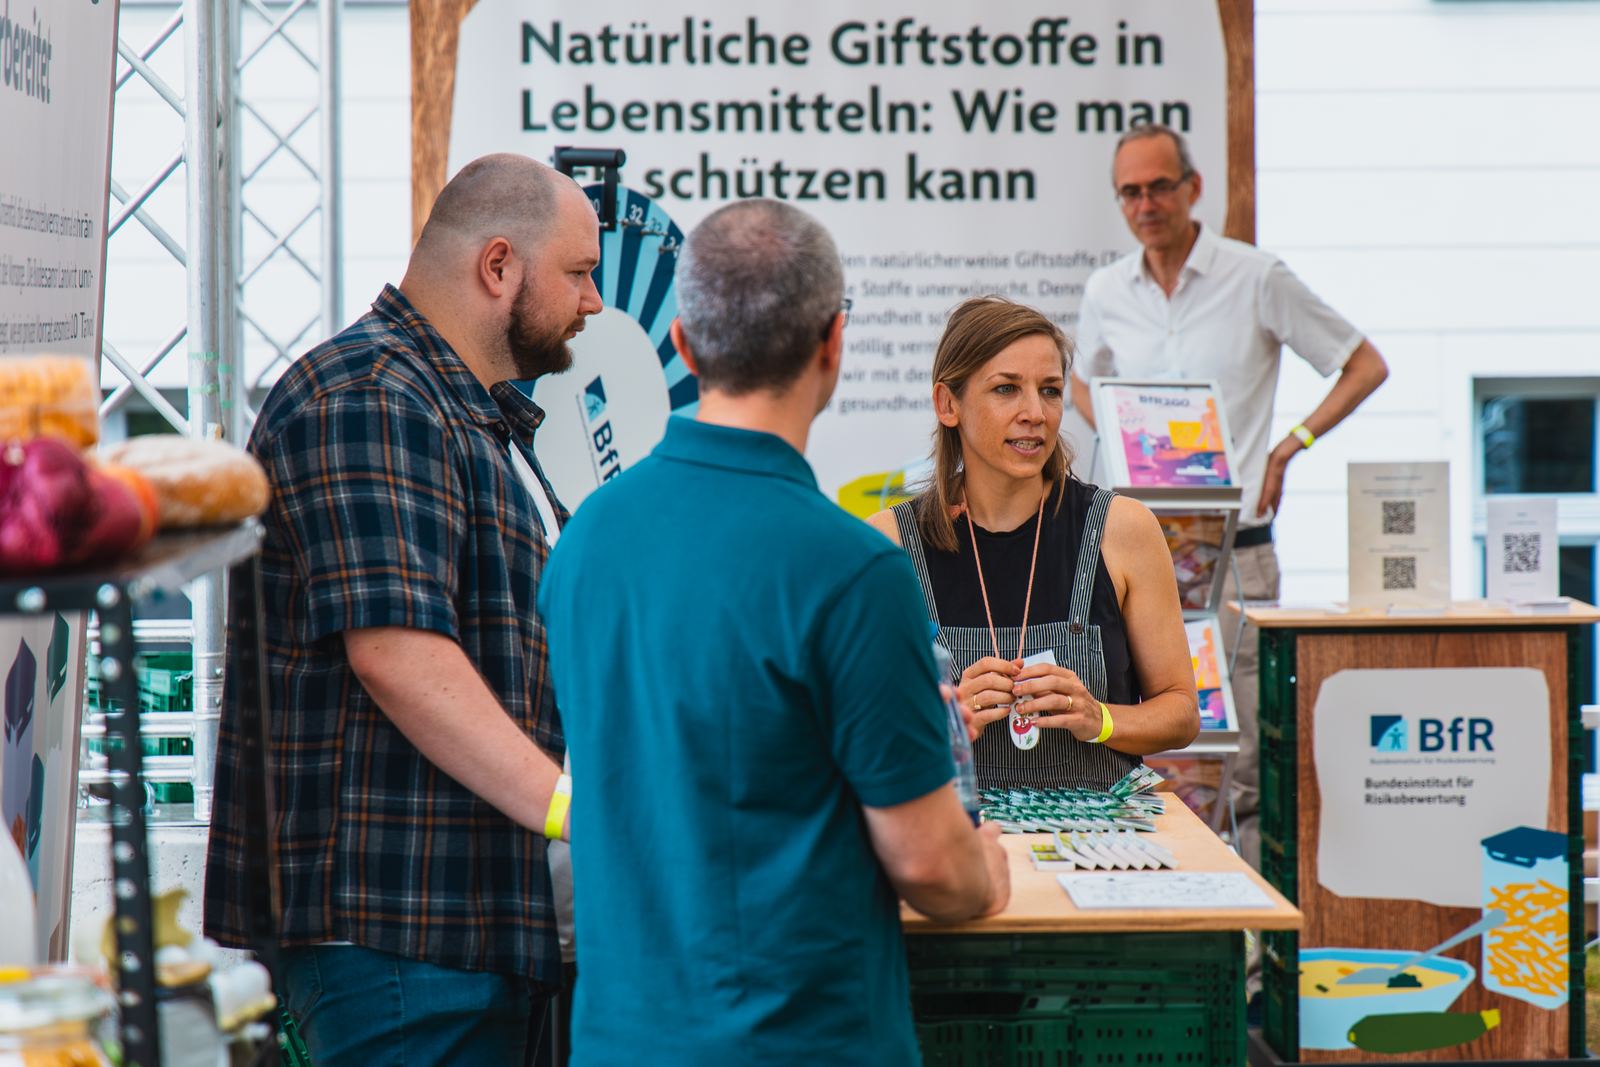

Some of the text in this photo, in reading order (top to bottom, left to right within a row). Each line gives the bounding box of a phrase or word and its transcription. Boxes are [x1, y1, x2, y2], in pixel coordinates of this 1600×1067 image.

[520, 16, 1163, 67] Natürliche Giftstoffe in
[520, 84, 1192, 134] Lebensmitteln: Wie man
[644, 152, 886, 202] schützen
[907, 152, 1036, 202] kann
[629, 203, 644, 224] 32
[1014, 250, 1099, 270] Giftstoffe
[861, 278, 911, 298] Stoffe
[848, 337, 894, 359] völlig
[871, 368, 899, 381] mit
[1418, 716, 1495, 753] BfR
[1364, 776, 1475, 790] Bundesinstitut für
[1364, 793, 1467, 806] Risikobewertung
